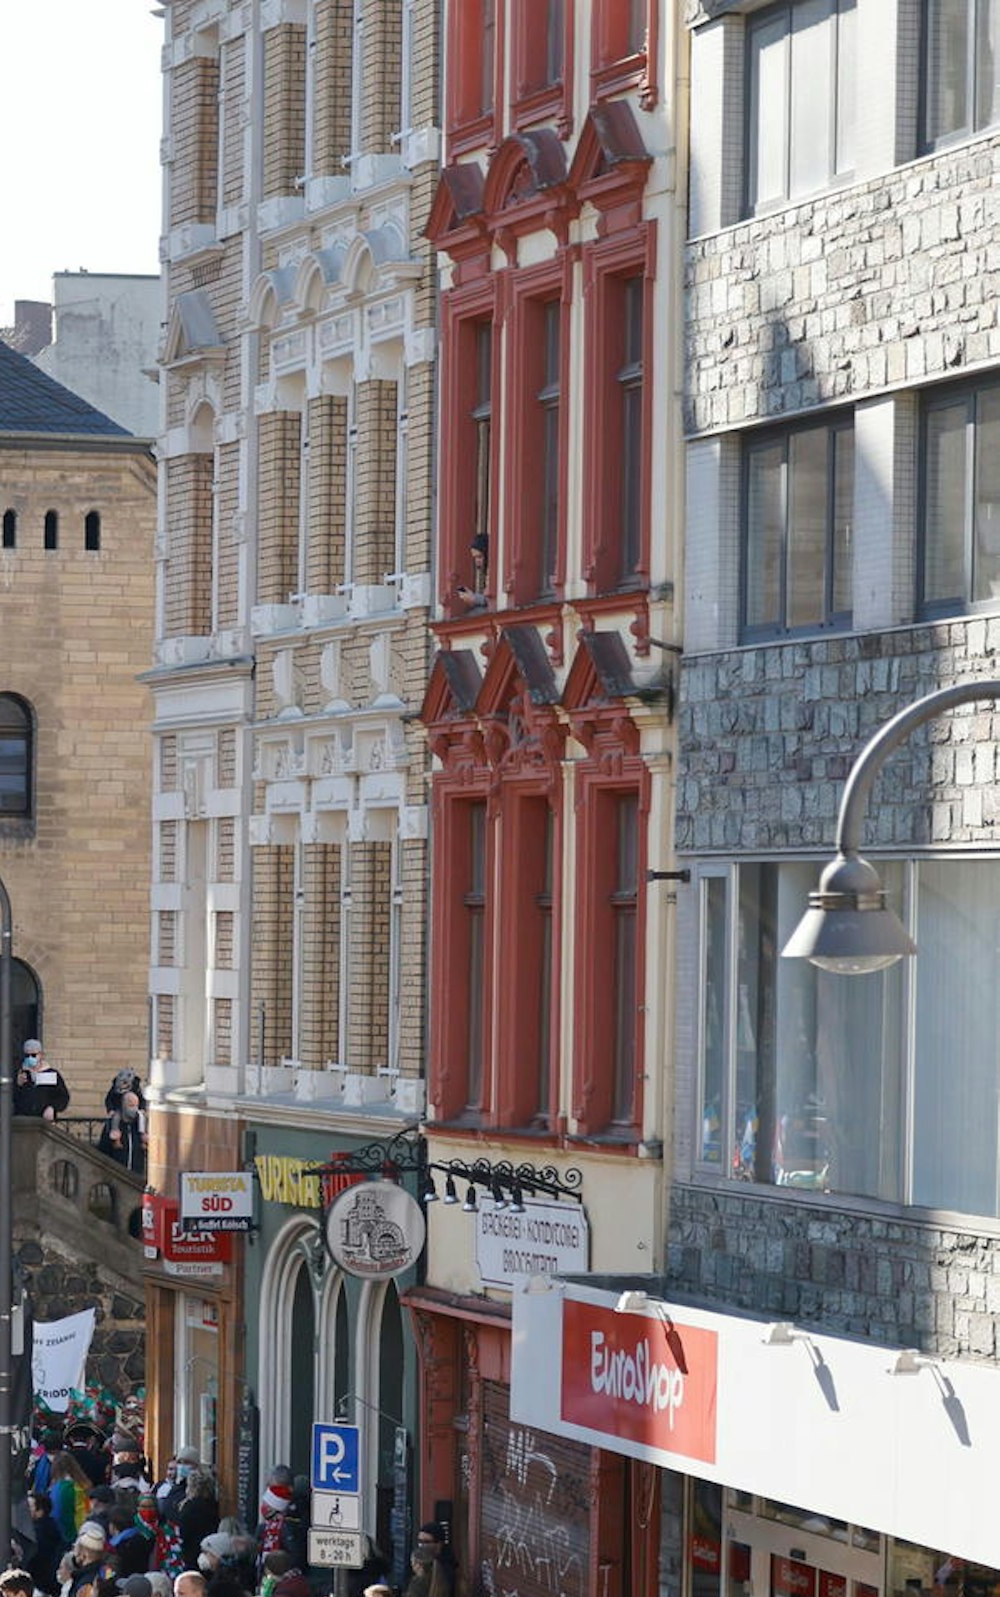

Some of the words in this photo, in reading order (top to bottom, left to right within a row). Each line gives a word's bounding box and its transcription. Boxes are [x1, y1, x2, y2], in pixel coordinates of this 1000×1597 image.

[202, 1194, 233, 1212] SÜD
[176, 1264, 212, 1273] Partner
[591, 1331, 684, 1431] EuroShop
[319, 1433, 345, 1482] P
[316, 1536, 354, 1550] werktags
